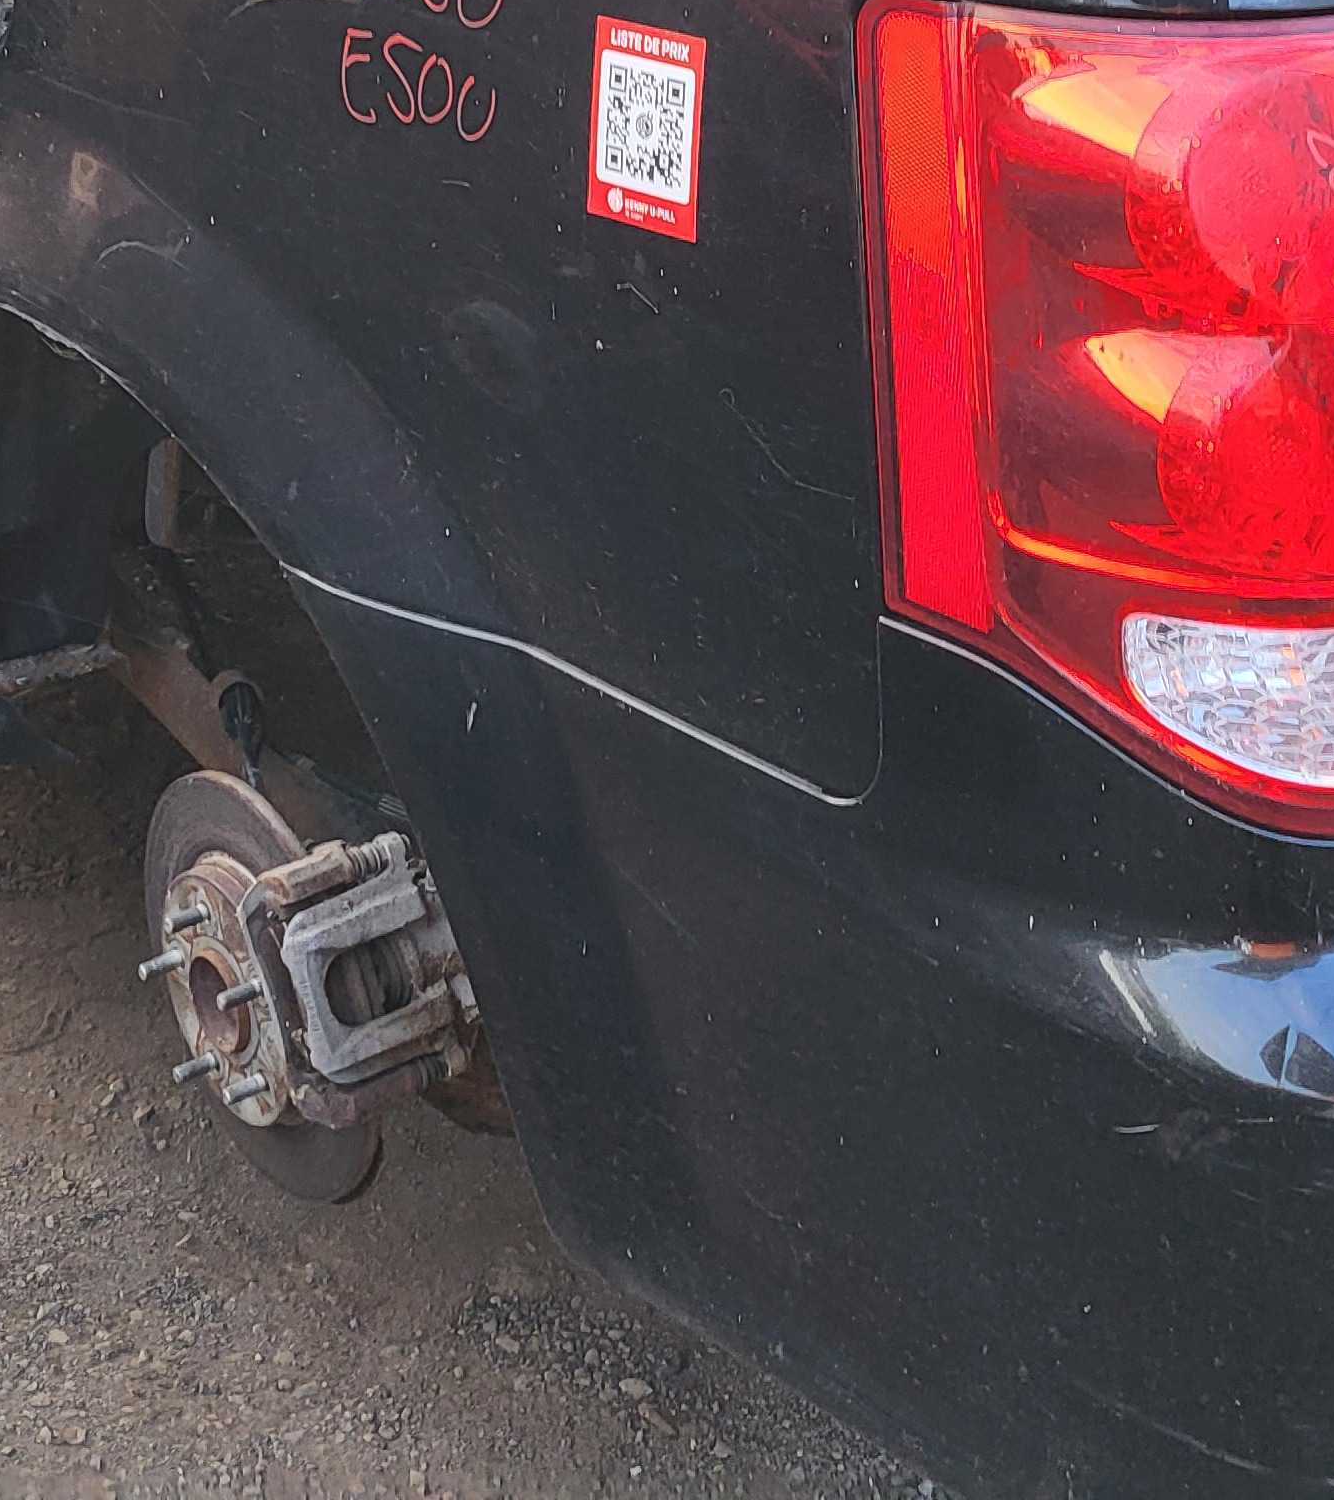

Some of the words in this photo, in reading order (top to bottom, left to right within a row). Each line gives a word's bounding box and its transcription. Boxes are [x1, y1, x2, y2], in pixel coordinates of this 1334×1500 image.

[610, 27, 643, 52] LISTE
[643, 34, 660, 56] DE
[661, 38, 690, 63] PRIX
